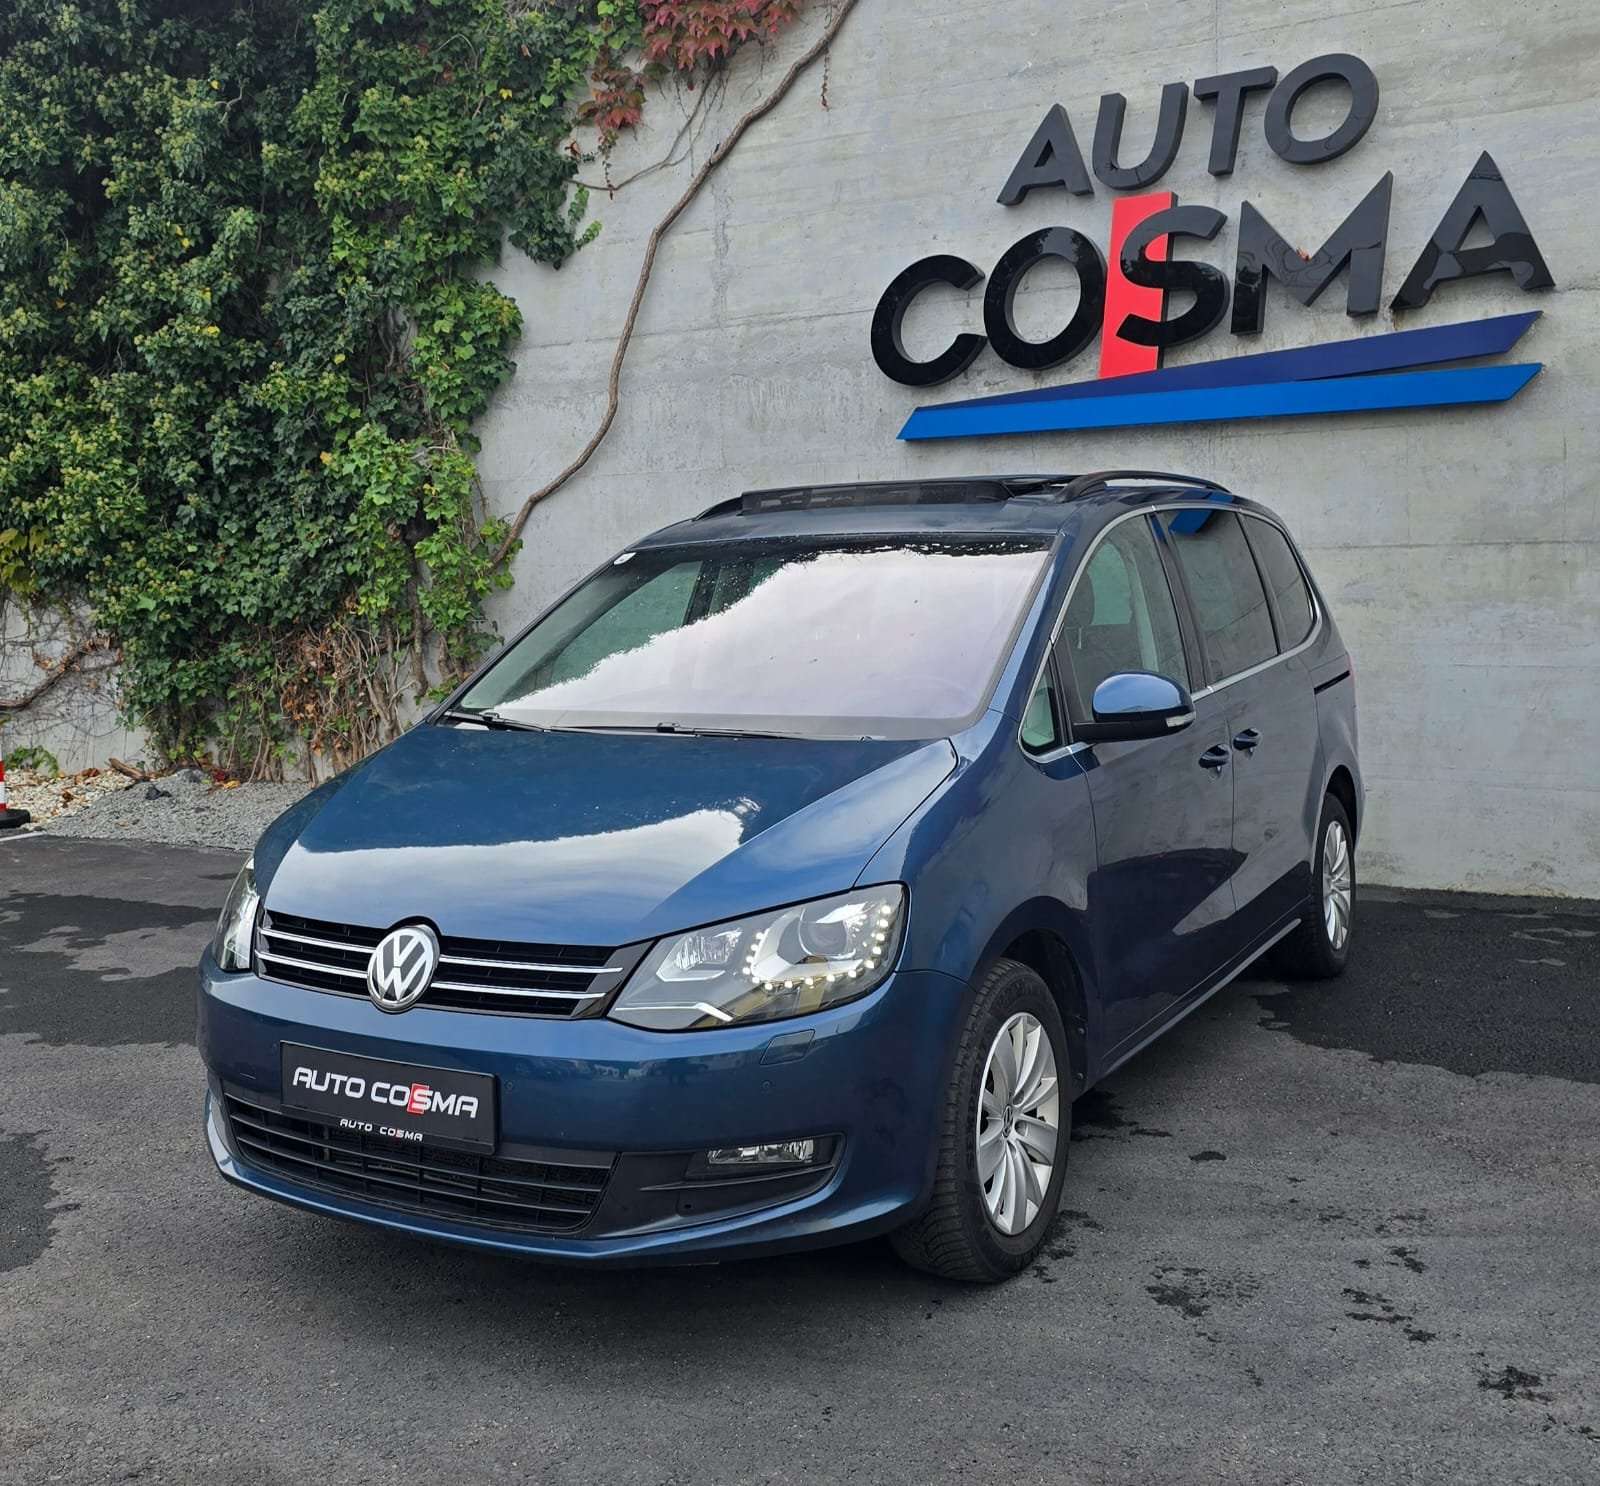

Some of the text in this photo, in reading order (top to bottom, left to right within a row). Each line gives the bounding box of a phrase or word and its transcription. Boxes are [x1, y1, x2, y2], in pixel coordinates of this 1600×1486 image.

[998, 53, 1379, 206] AUTO
[871, 151, 1556, 386] COSMA
[371, 929, 433, 1002] VW
[292, 1067, 479, 1118] AUTO COSMA
[339, 1118, 423, 1142] AUTO COSMA
